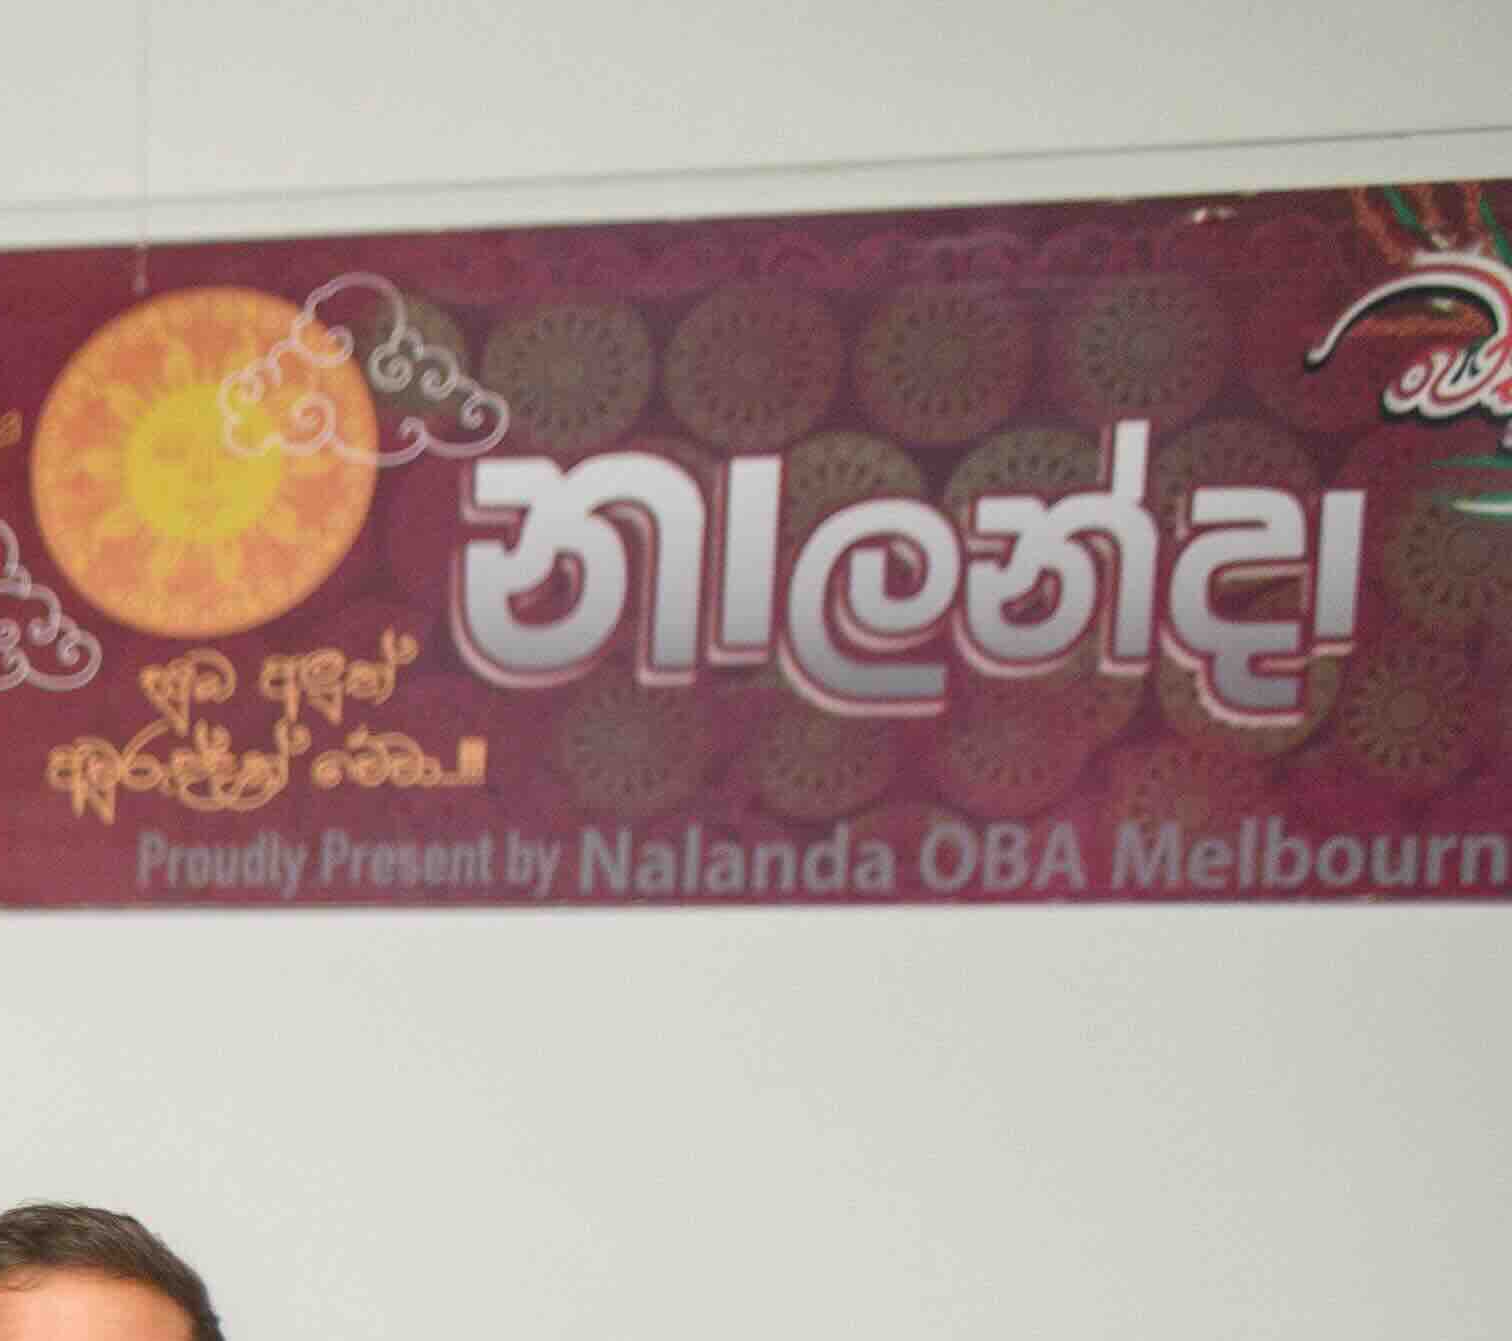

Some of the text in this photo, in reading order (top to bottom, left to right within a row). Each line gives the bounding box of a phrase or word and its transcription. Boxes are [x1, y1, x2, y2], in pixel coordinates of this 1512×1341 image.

[137, 831, 307, 898] Proudly
[320, 829, 494, 884] Present
[506, 828, 561, 898] by
[578, 823, 896, 895] Nalanda
[920, 818, 1084, 891] OBA
